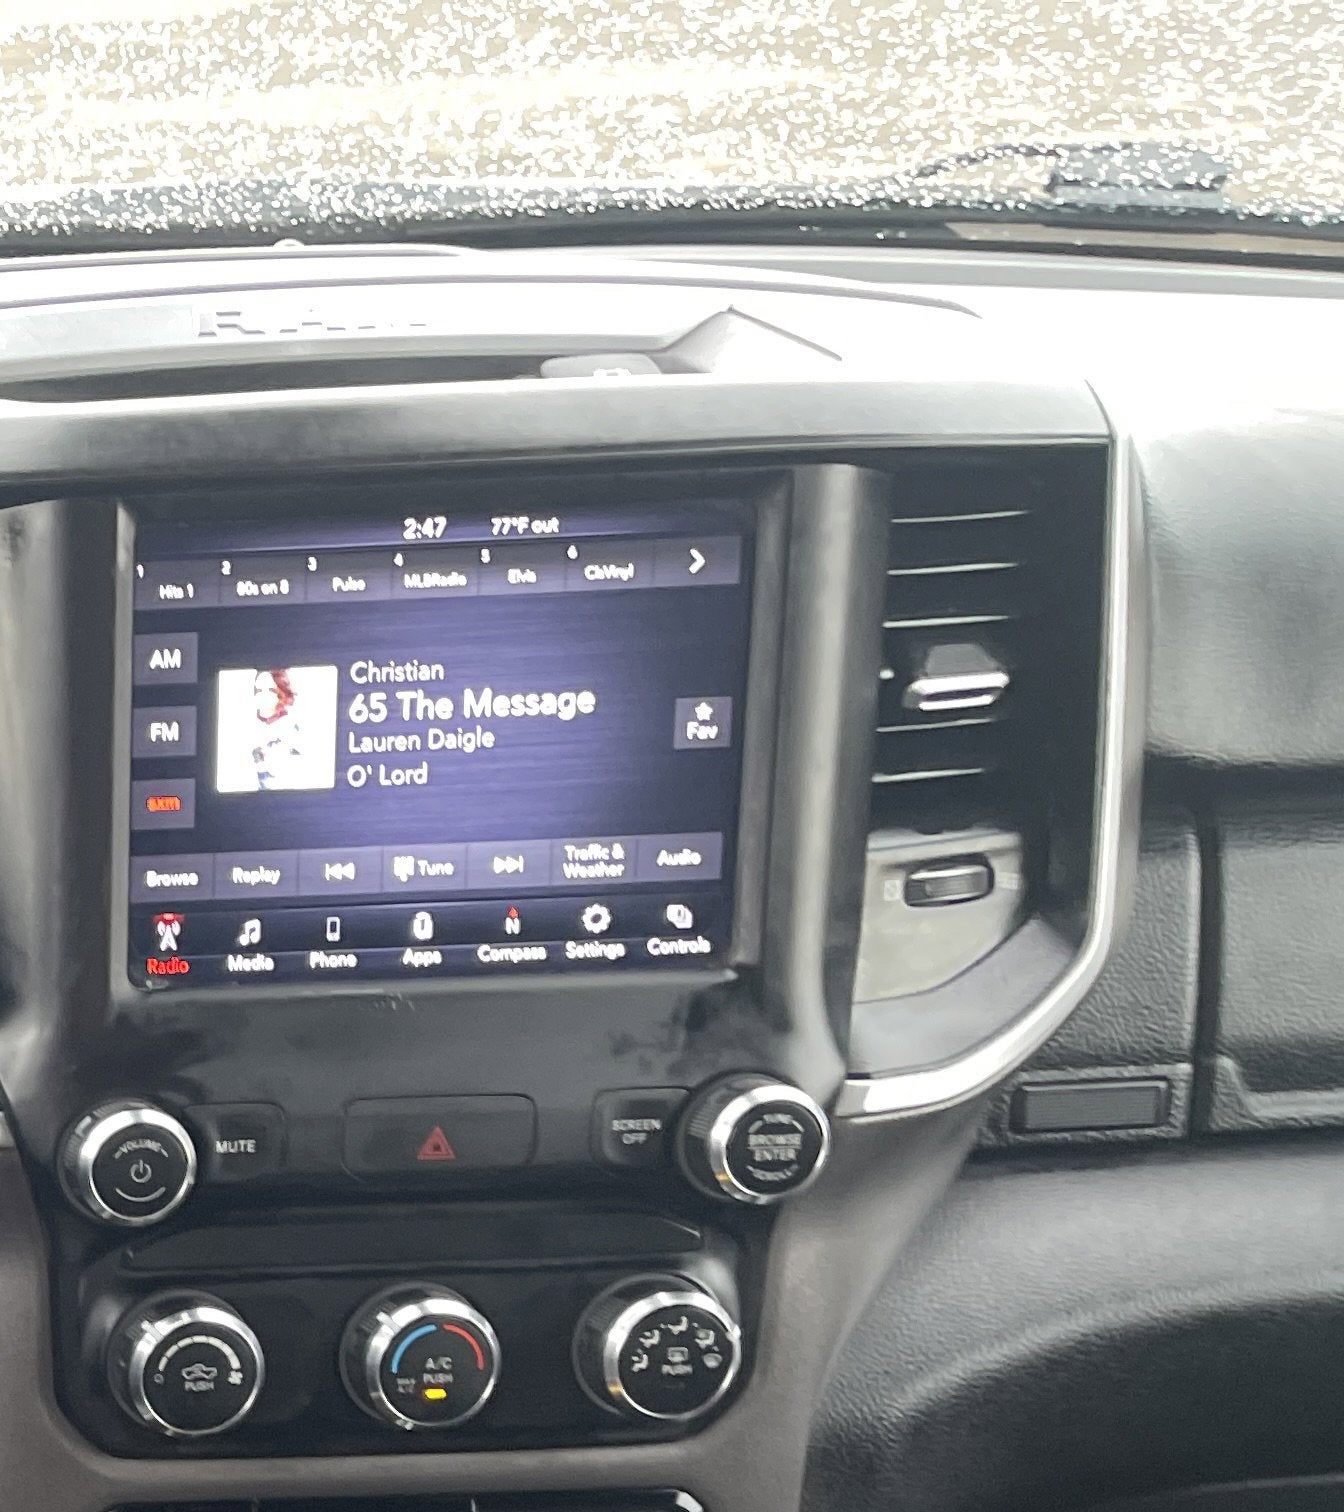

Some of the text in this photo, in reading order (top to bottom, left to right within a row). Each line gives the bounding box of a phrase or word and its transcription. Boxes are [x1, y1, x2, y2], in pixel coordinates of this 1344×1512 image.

[403, 516, 560, 539] 2:47 77°F out
[136, 563, 145, 578] 1
[221, 560, 232, 575] 2
[307, 556, 318, 572] 3
[393, 552, 404, 567] 4
[480, 548, 491, 563] 5
[332, 576, 367, 592] Pulse
[507, 568, 537, 584] Elvis
[159, 584, 184, 599] Hits
[261, 583, 278, 595] on
[149, 648, 181, 669] AM
[350, 659, 445, 685] Christian
[348, 688, 596, 724] 65 The Message
[151, 722, 179, 743] FM
[348, 725, 495, 754] Lauren Daigle
[686, 722, 718, 741] Fav
[347, 761, 428, 788] O' Lord
[564, 843, 624, 861] Traffic &
[657, 848, 701, 867] Audio
[146, 859, 454, 888] Browse Replay Tune
[563, 861, 625, 879] Weather
[146, 935, 711, 975] Radio Media Phone Apps Compass Settings Controls
[612, 1119, 661, 1131] SCREEN
[119, 1139, 162, 1154] VOLUME
[215, 1139, 257, 1154] MUTE
[622, 1133, 647, 1145] OFF
[748, 1134, 802, 1146] BROWSE
[754, 1149, 797, 1161] ENTER
[424, 1356, 453, 1370] A/C
[184, 1381, 215, 1392] PUSH
[423, 1373, 453, 1384] PUSH
